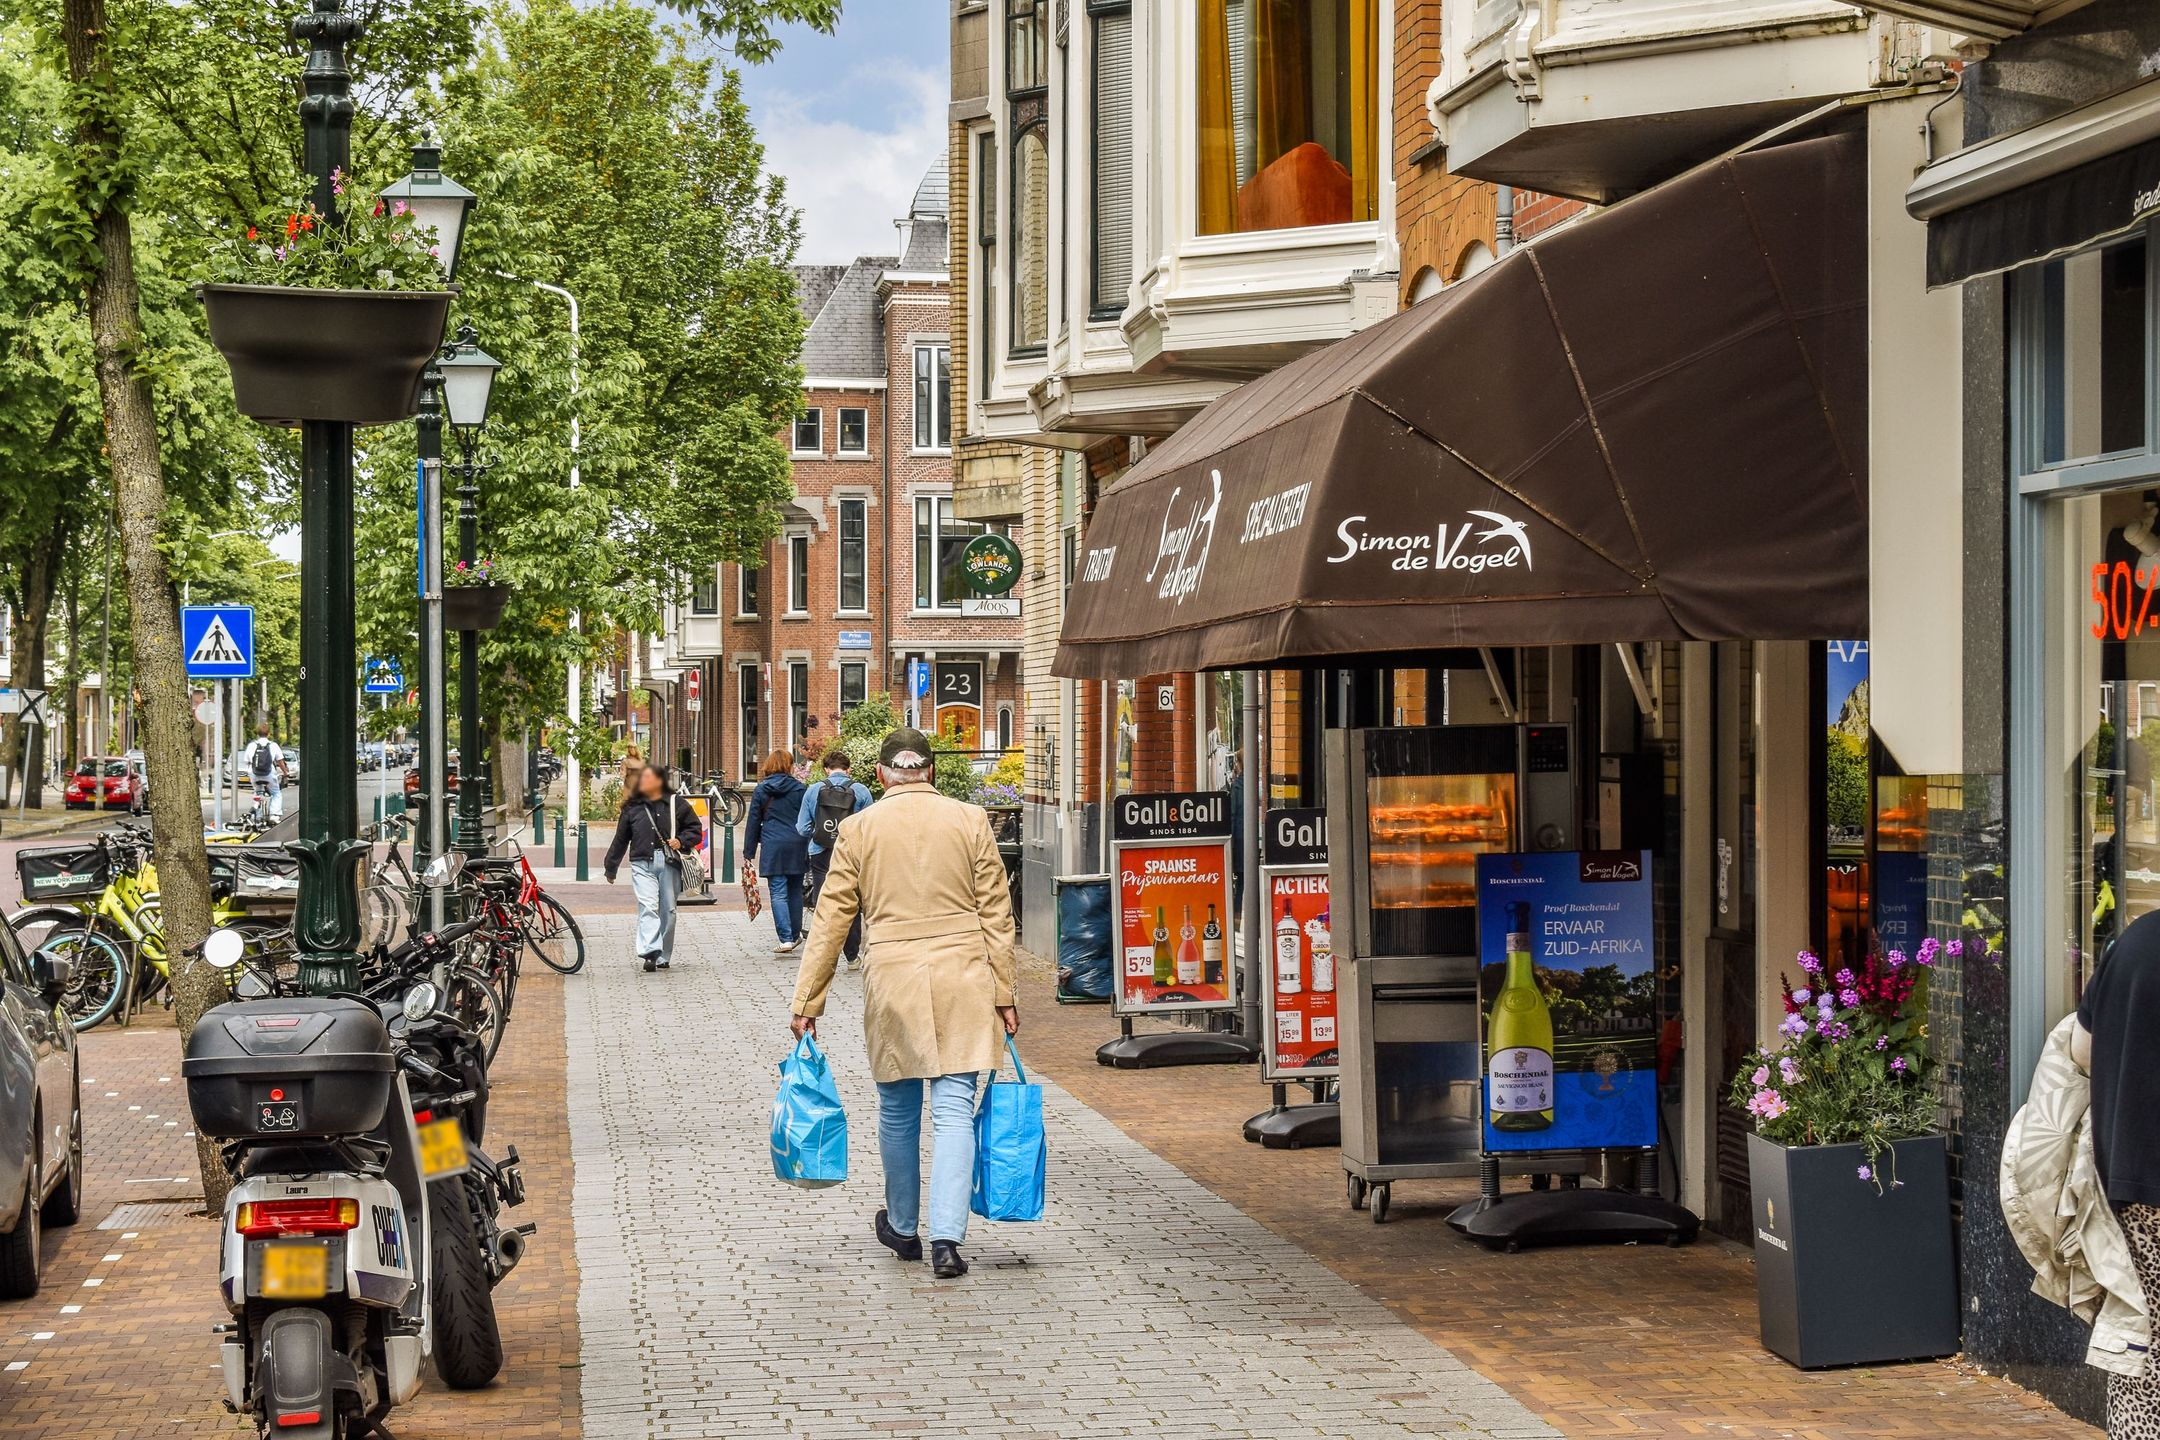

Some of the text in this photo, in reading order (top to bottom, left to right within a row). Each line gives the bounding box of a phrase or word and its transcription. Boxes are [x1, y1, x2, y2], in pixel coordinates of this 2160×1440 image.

[1240, 481, 1312, 544] SPECIALITEITEN
[1146, 486, 1187, 583] Simon
[1326, 516, 1431, 563] Simon
[1159, 497, 1207, 606] de Vogel
[1392, 522, 1520, 574] de Vogel
[966, 560, 1012, 574] LOWLANDER
[2092, 561, 2159, 640] 50%
[300, 666, 306, 680] 8
[920, 673, 926, 688] P
[944, 674, 971, 695] 23
[1144, 858, 1197, 874] SPAANSE
[1584, 862, 1612, 877] Simon
[1612, 864, 1635, 880] Vogel
[1121, 870, 1220, 896] Prijswinnaars
[1544, 902, 1620, 914] Proef Boschendal
[1544, 920, 1605, 936] ERVAAR
[1544, 939, 1644, 956] ZUID-AFRIKA
[285, 1186, 309, 1195] Laura
